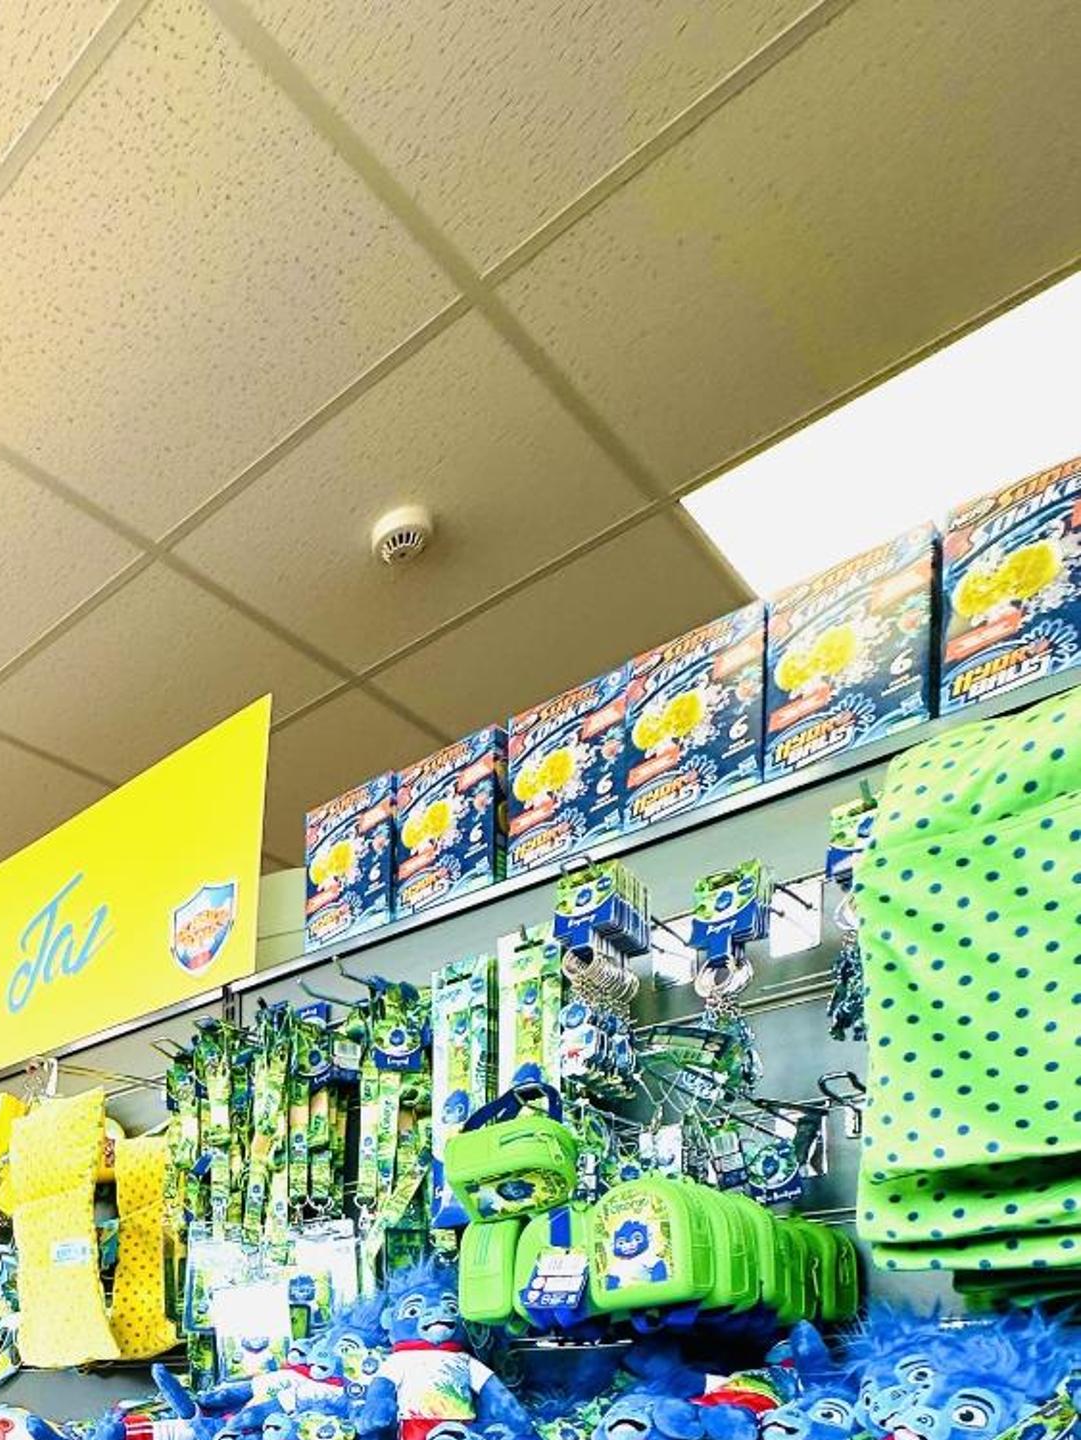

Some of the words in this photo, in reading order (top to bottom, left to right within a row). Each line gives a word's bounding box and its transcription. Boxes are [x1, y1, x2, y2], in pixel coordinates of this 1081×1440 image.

[890, 649, 914, 676] 6
[729, 715, 748, 740] 6
[596, 771, 613, 795] 6
[470, 822, 483, 842] 6
[370, 862, 382, 882] 6
[8, 872, 116, 1013] Jaz
